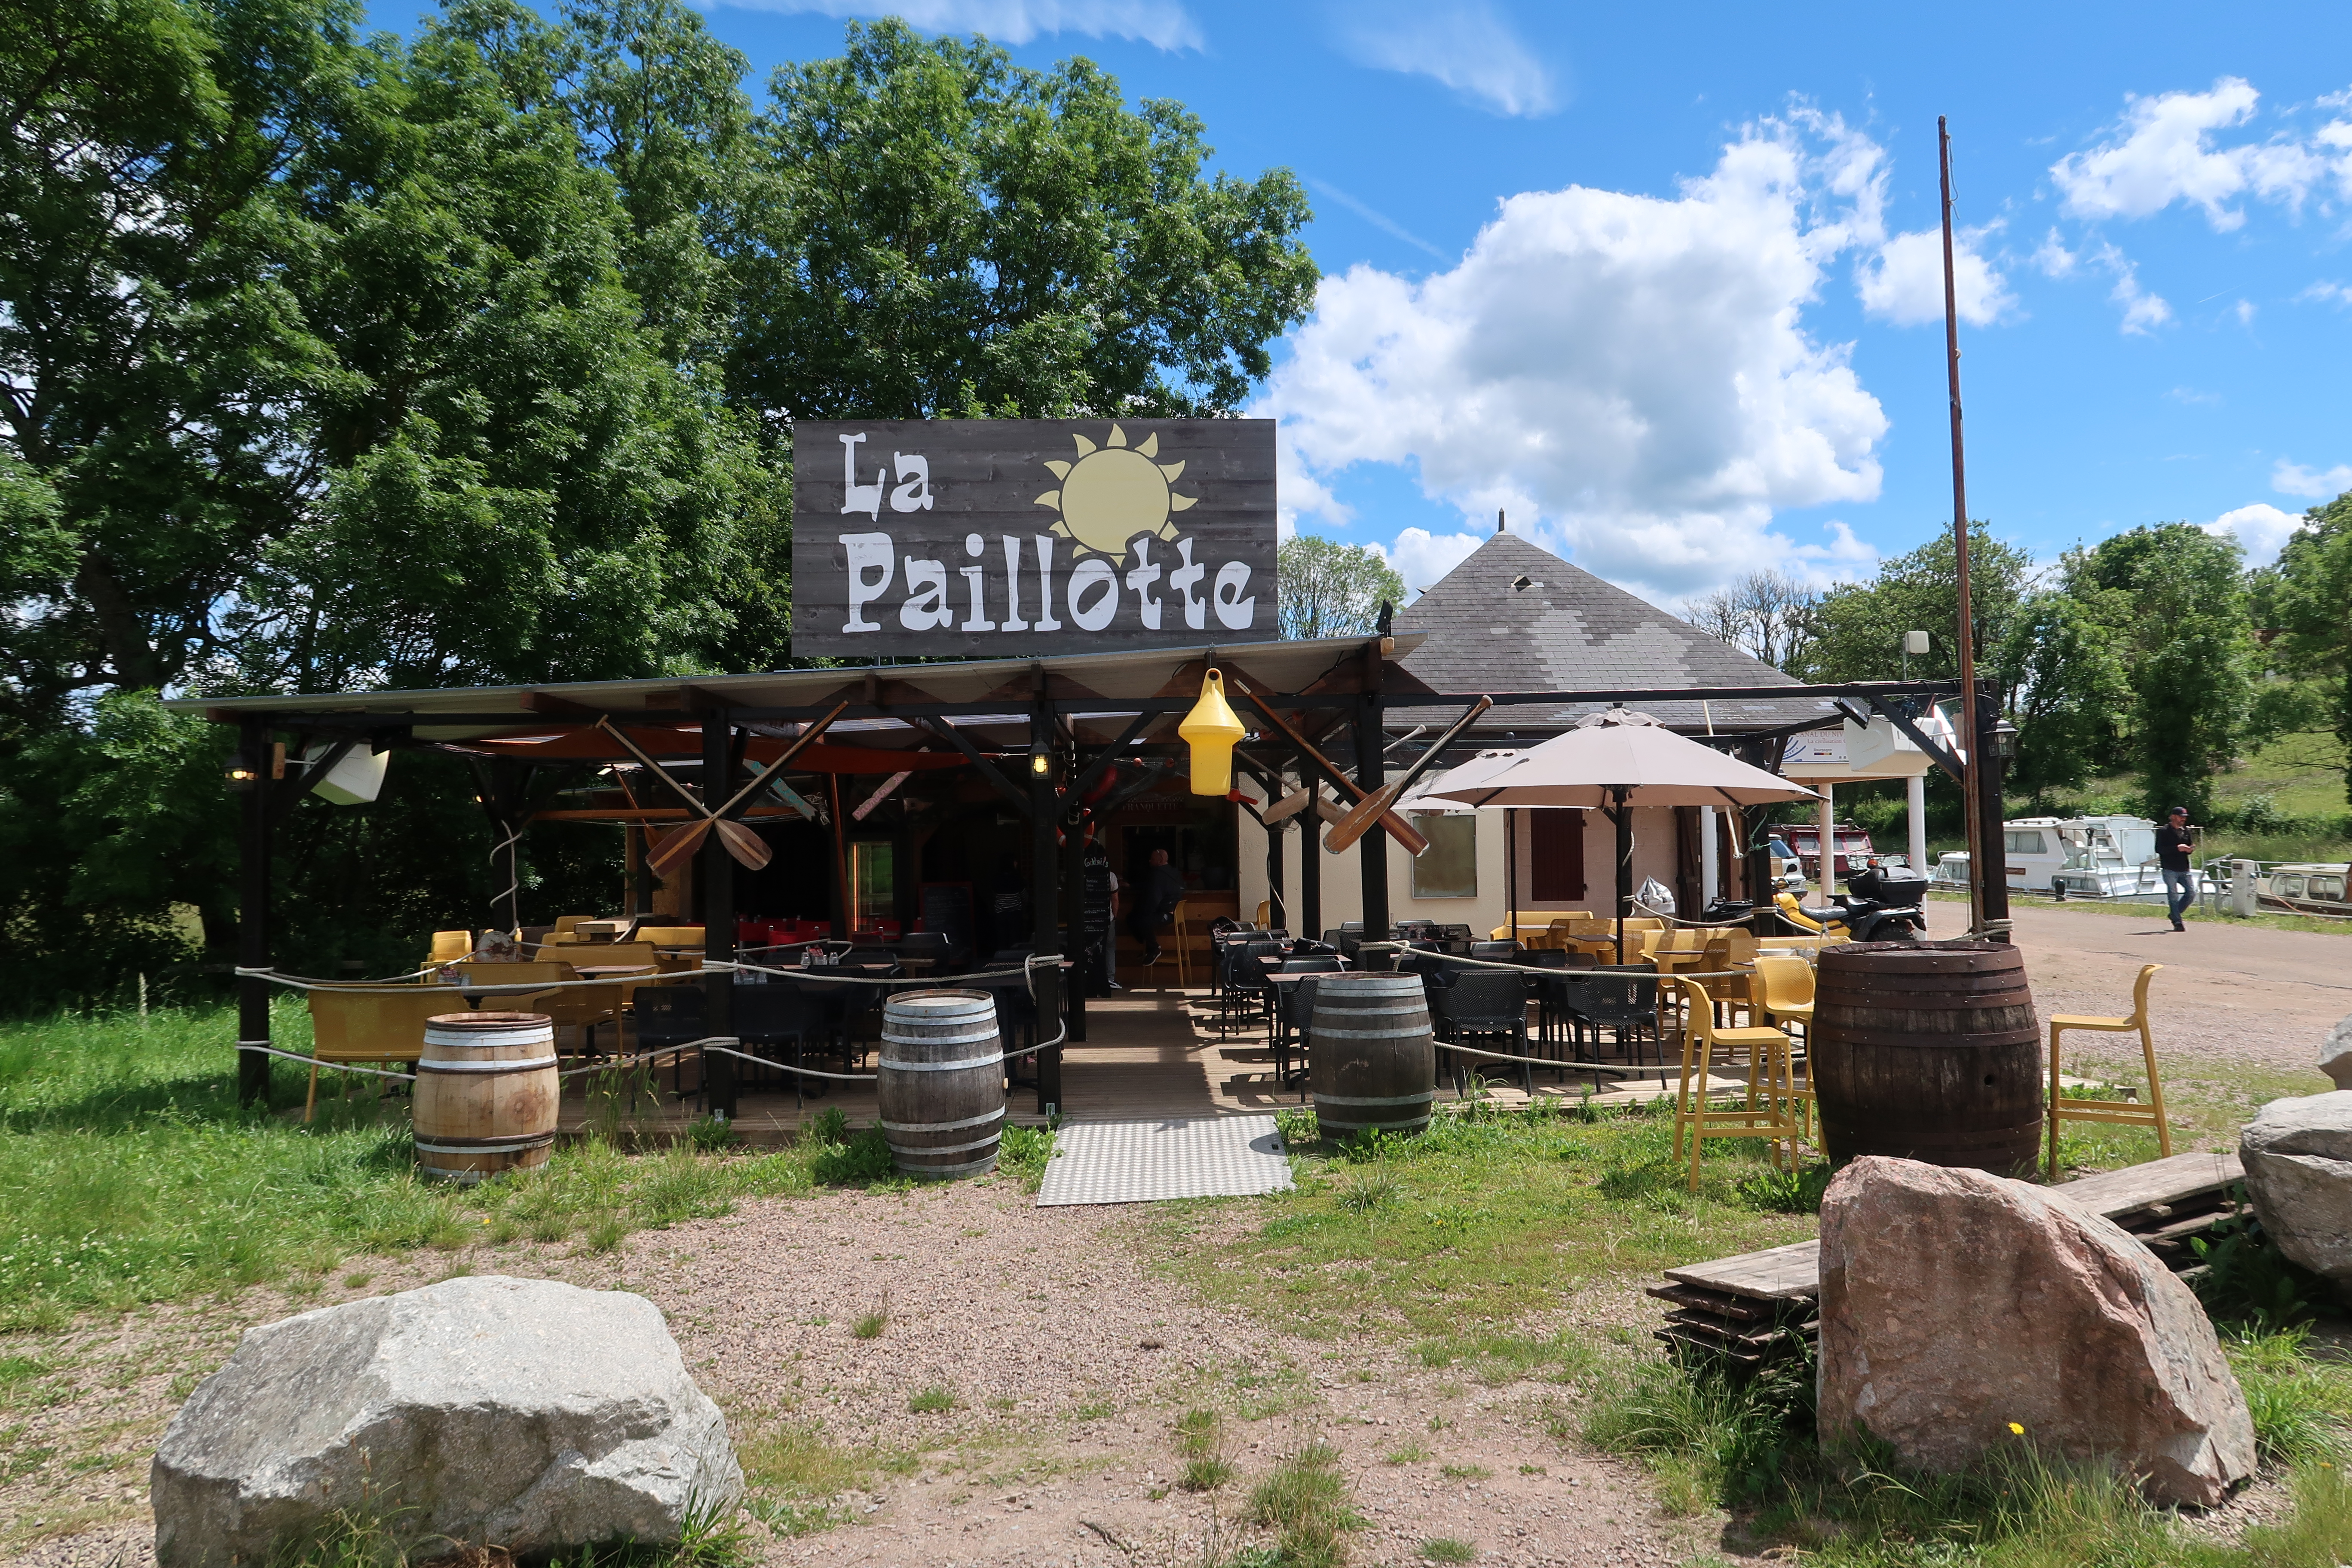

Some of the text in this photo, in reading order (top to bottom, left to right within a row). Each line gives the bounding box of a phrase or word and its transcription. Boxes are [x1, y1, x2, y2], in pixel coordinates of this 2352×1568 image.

[839, 432, 934, 522] La
[839, 533, 1255, 633] Paillotte
[1084, 856, 1109, 868] Cocktails
